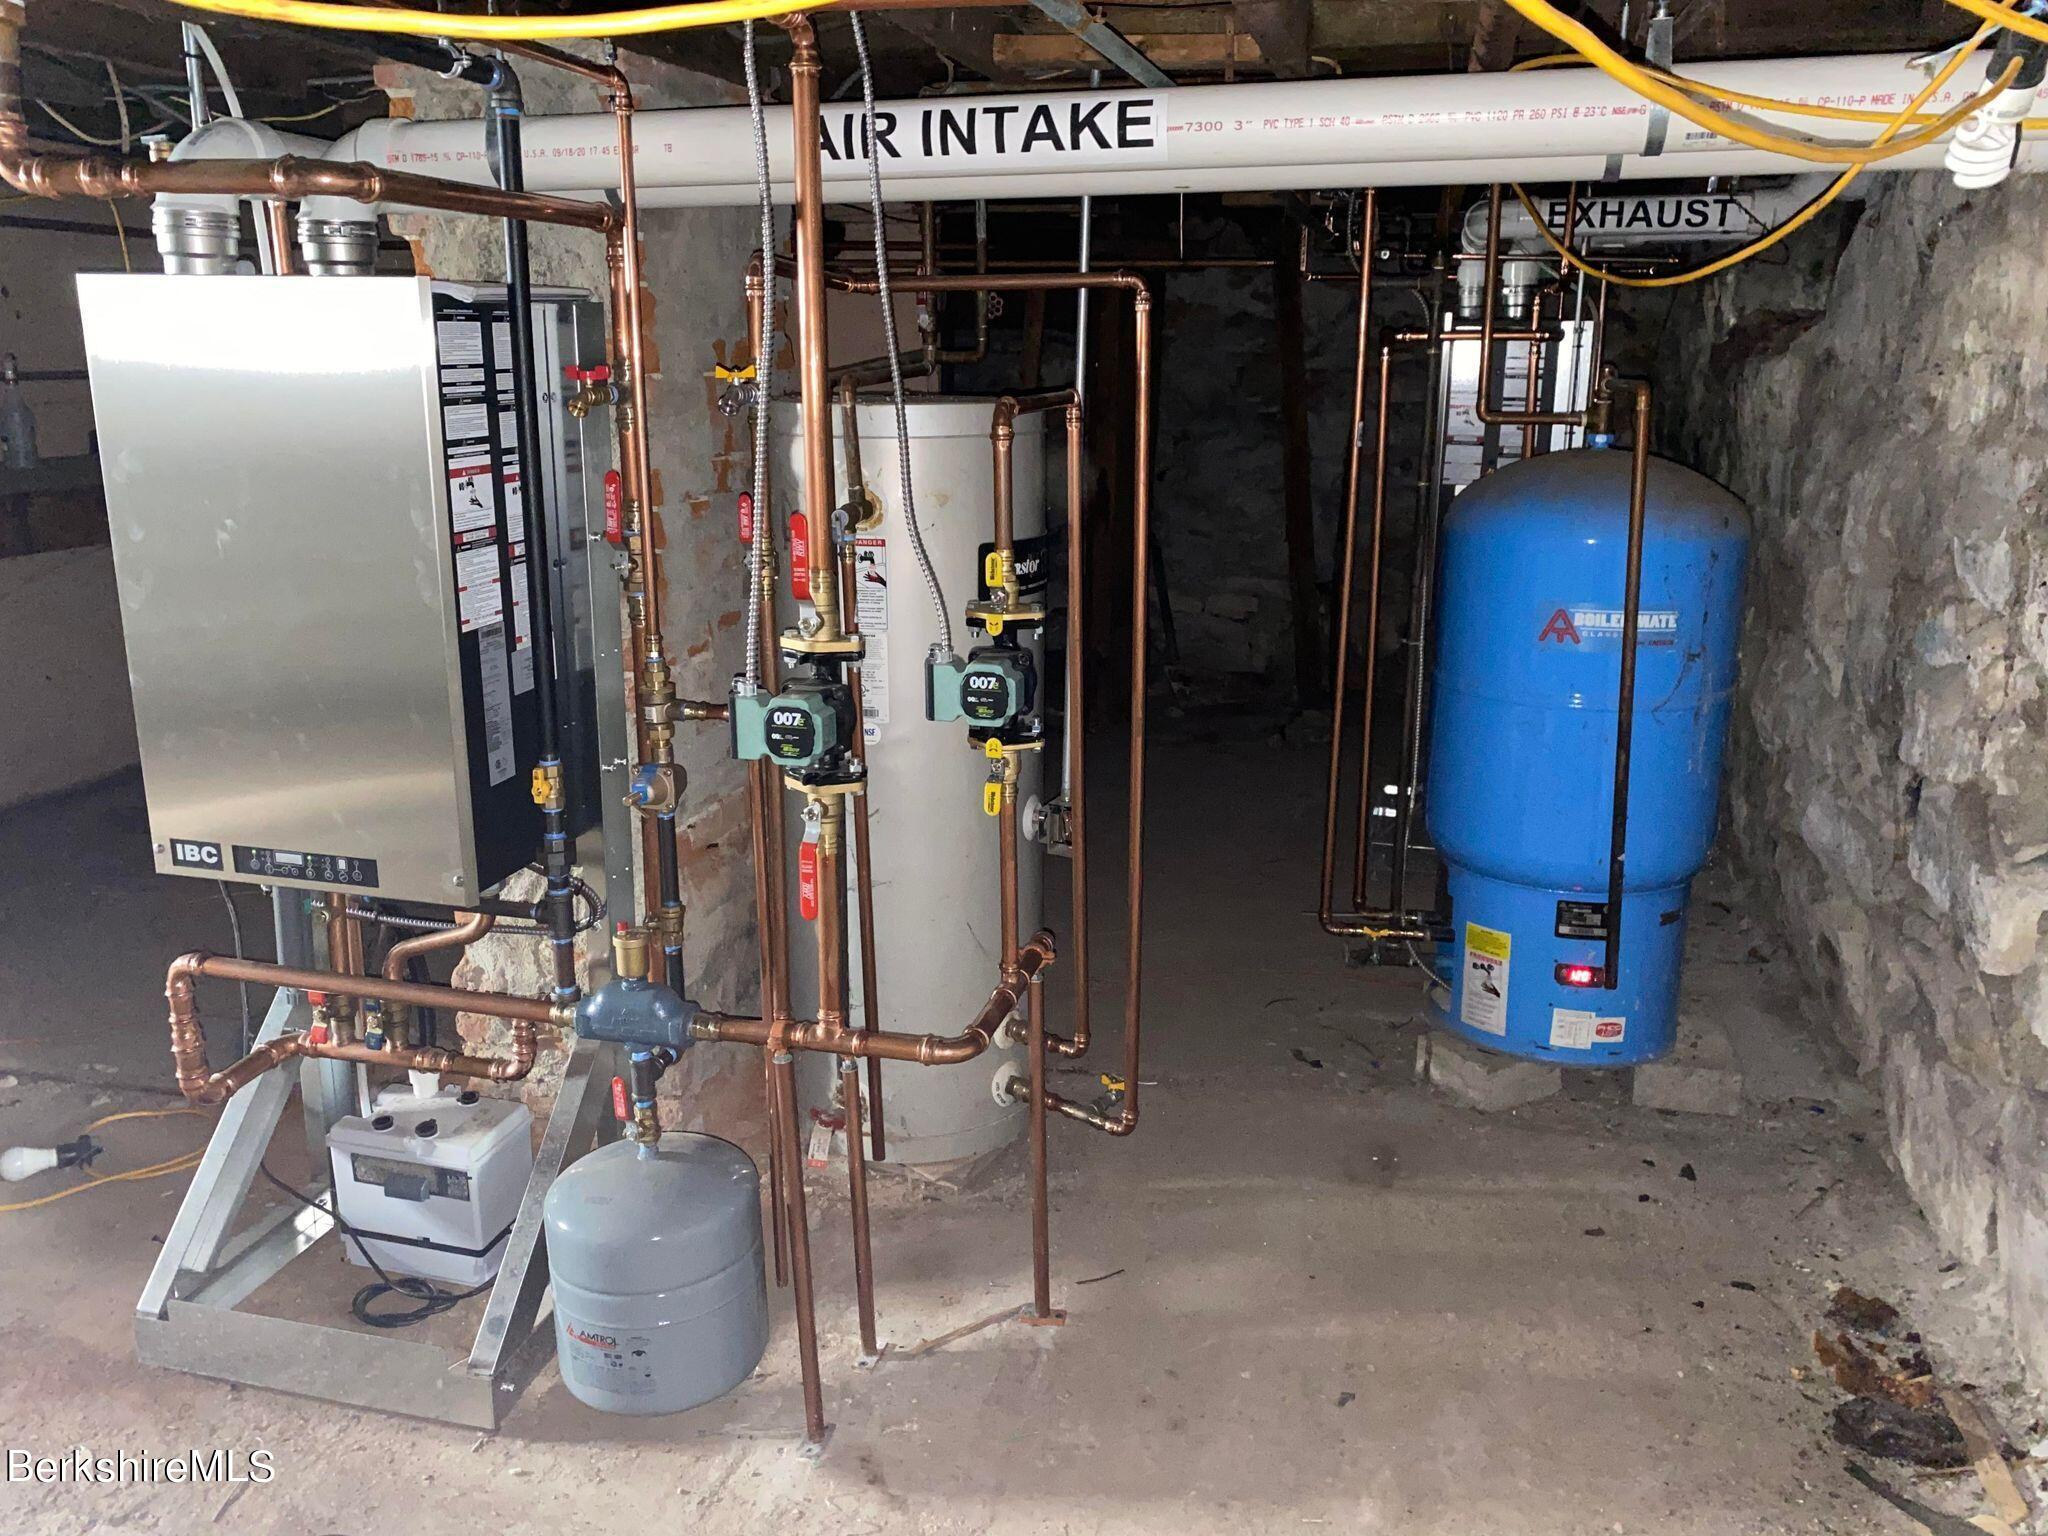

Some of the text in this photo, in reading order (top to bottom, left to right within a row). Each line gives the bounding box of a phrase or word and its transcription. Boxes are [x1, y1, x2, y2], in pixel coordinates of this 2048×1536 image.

[1871, 93, 1897, 105] MADE
[1529, 108, 1546, 120] 260
[1551, 107, 1567, 119] PSI
[818, 98, 1154, 160] AIR INTAKE
[1185, 121, 1223, 132] 7300
[1263, 118, 1279, 129] PVC
[1284, 117, 1304, 128] TYPE
[1319, 117, 1335, 127] SCH
[1340, 116, 1350, 126] 40
[1547, 199, 1737, 229] EXHAUST
[1573, 612, 1677, 629] BOILEMATE
[175, 843, 218, 864] IBC
[579, 1330, 617, 1348] AMTROL
